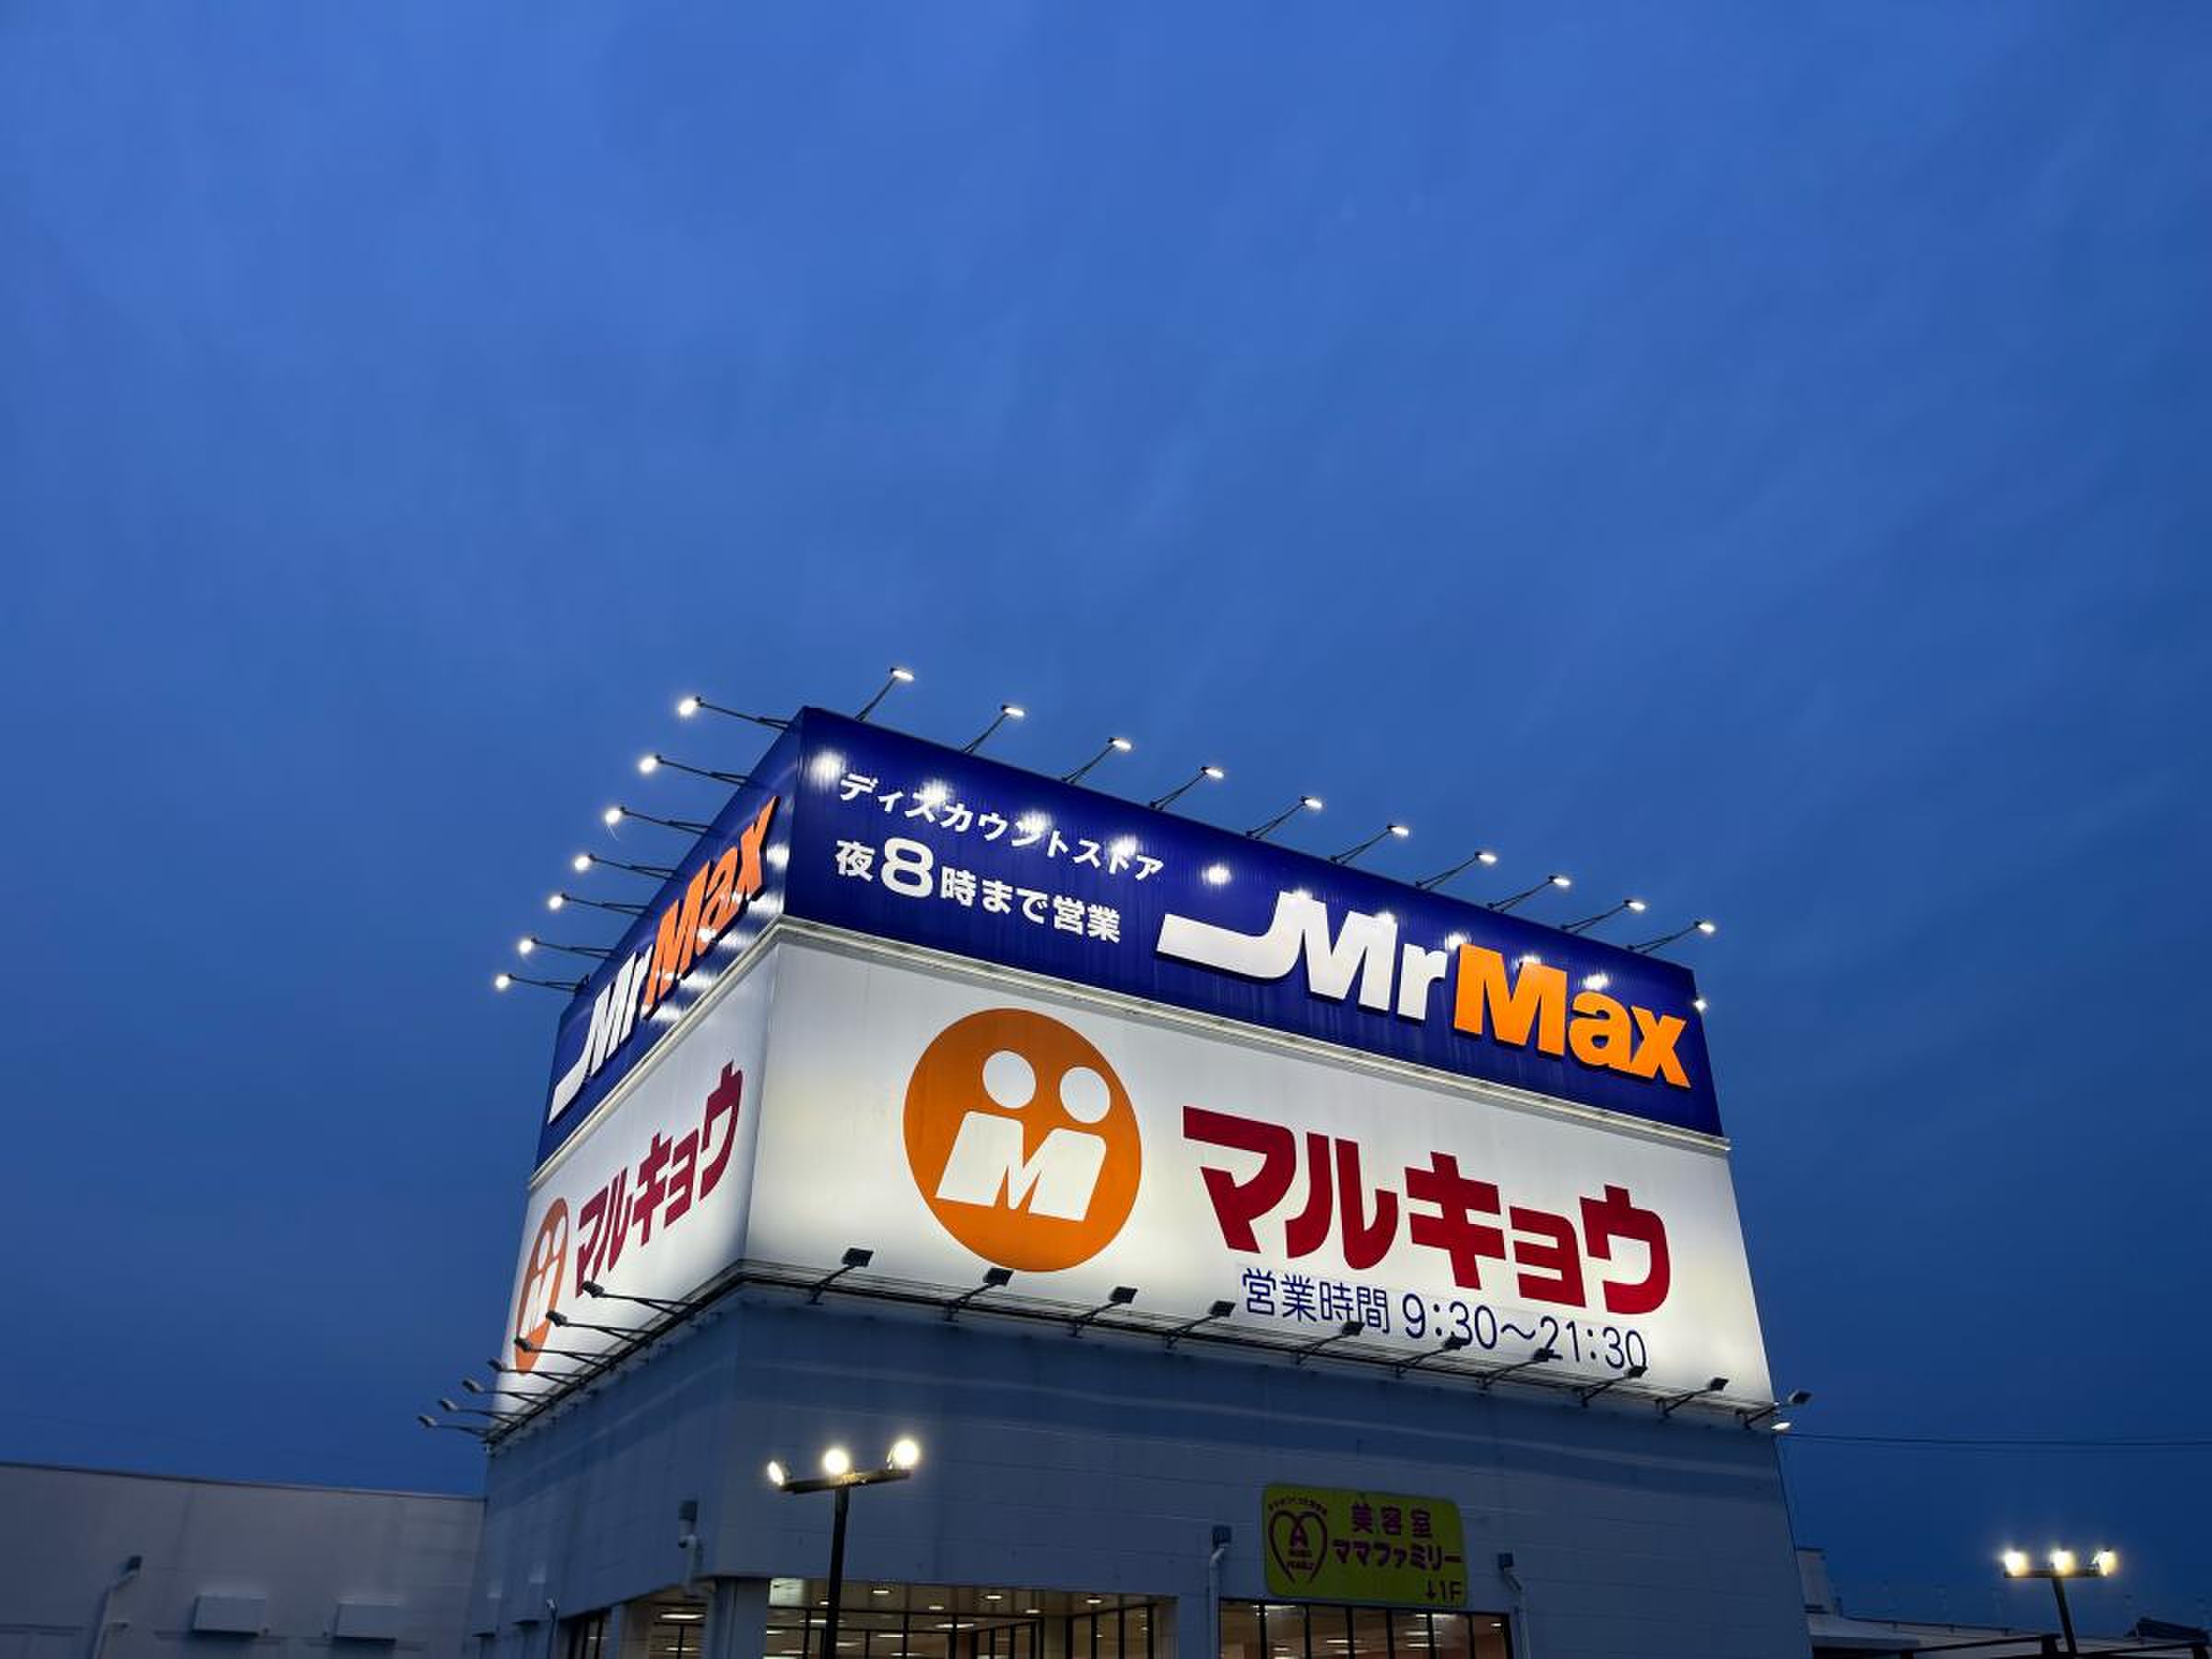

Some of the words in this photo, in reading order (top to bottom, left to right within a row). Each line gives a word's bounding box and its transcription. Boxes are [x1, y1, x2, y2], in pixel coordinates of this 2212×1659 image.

[839, 772, 1164, 882] ディスカウントストア
[835, 837, 1122, 945] 夜8時まで営業
[547, 795, 781, 1124] MrMax
[1156, 890, 1692, 1089] MrMax
[575, 1060, 744, 1300] マルキョウ
[1182, 1105, 1671, 1315] マルキョウ
[1241, 1267, 1391, 1335] 営業時間
[1333, 1538, 1461, 1571] ママファミリー
[1351, 1500, 1432, 1538] 美容室
